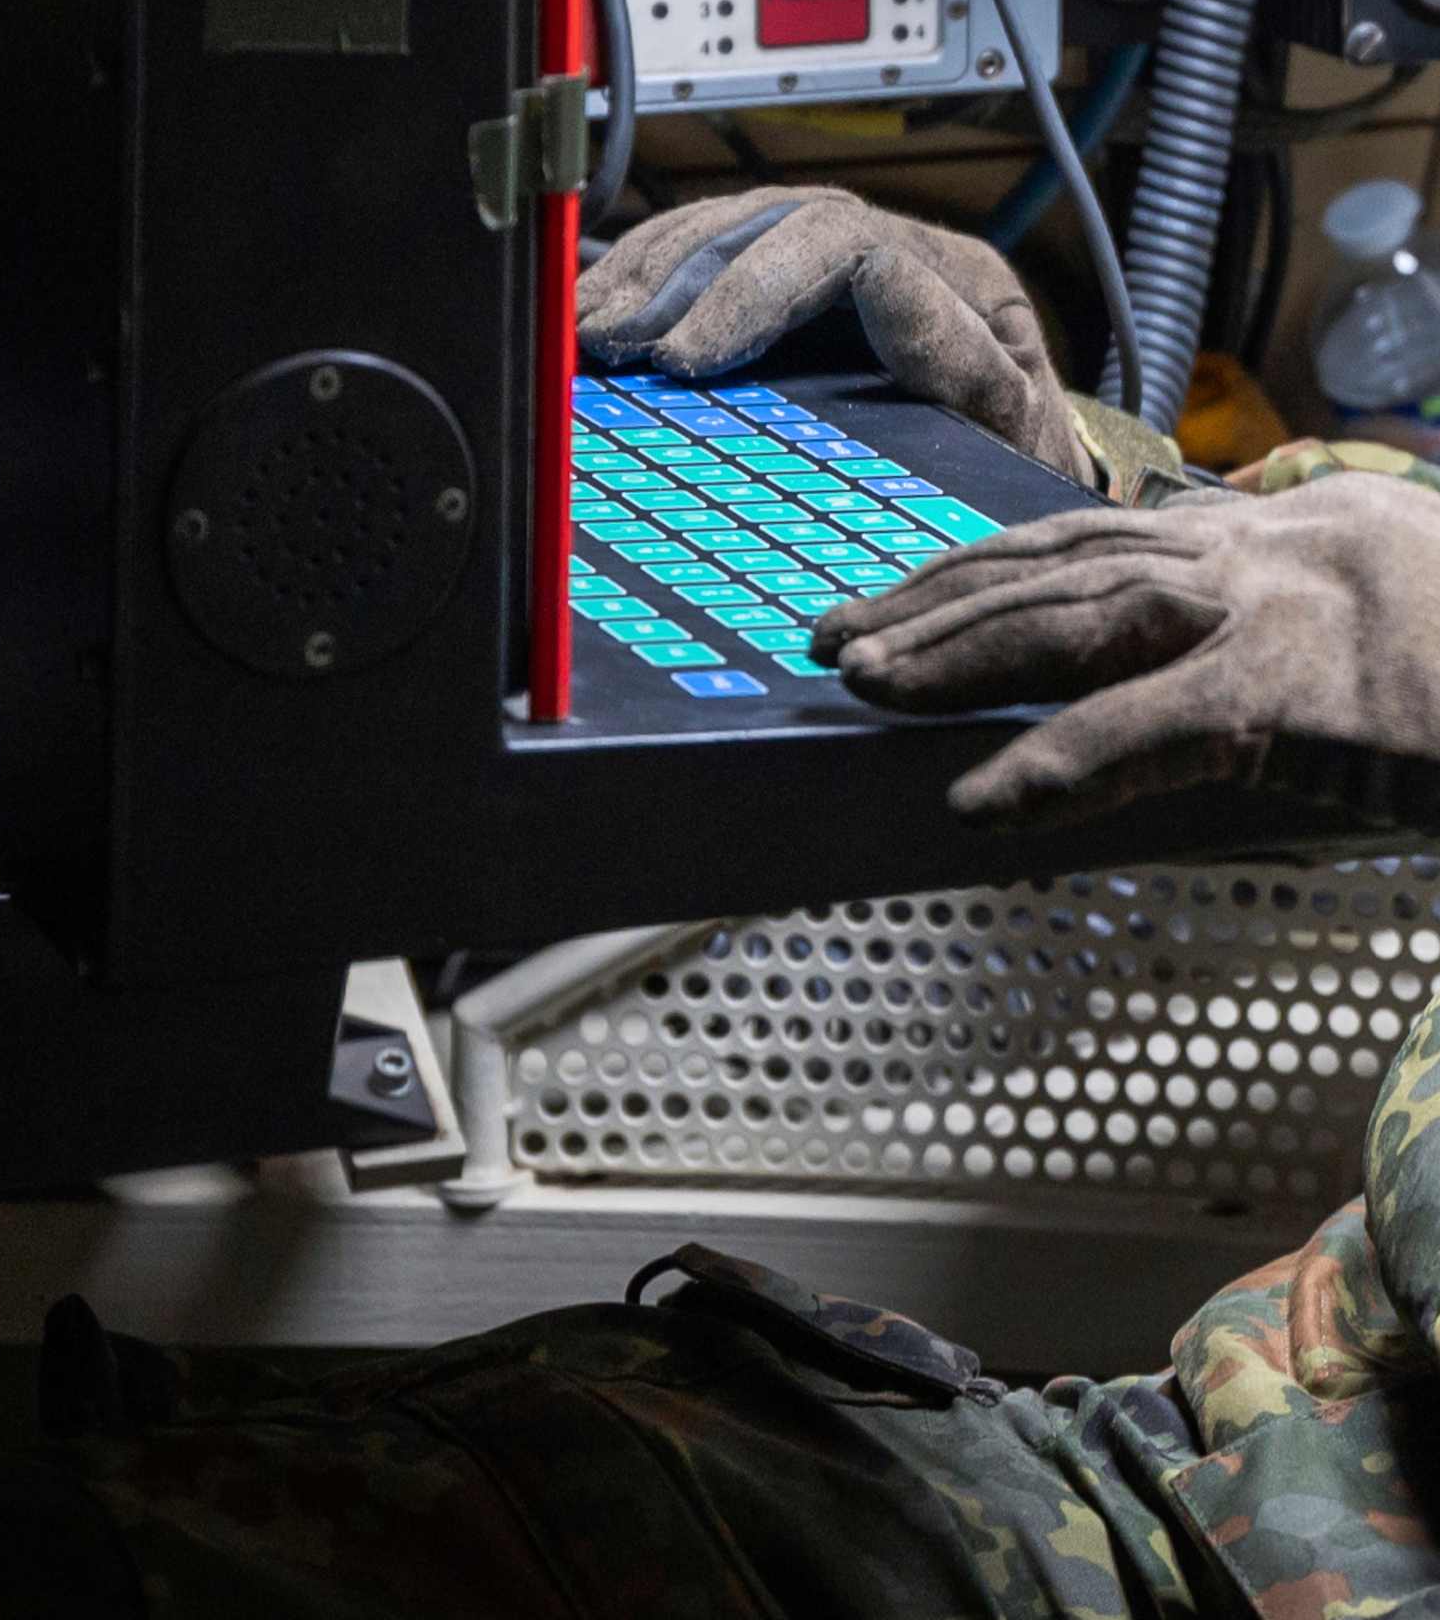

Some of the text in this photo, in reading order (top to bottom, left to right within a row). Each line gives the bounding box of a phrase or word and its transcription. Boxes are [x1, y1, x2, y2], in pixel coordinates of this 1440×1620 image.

[700, 3, 711, 18] 3
[913, 25, 925, 39] 4
[700, 40, 711, 55] 4
